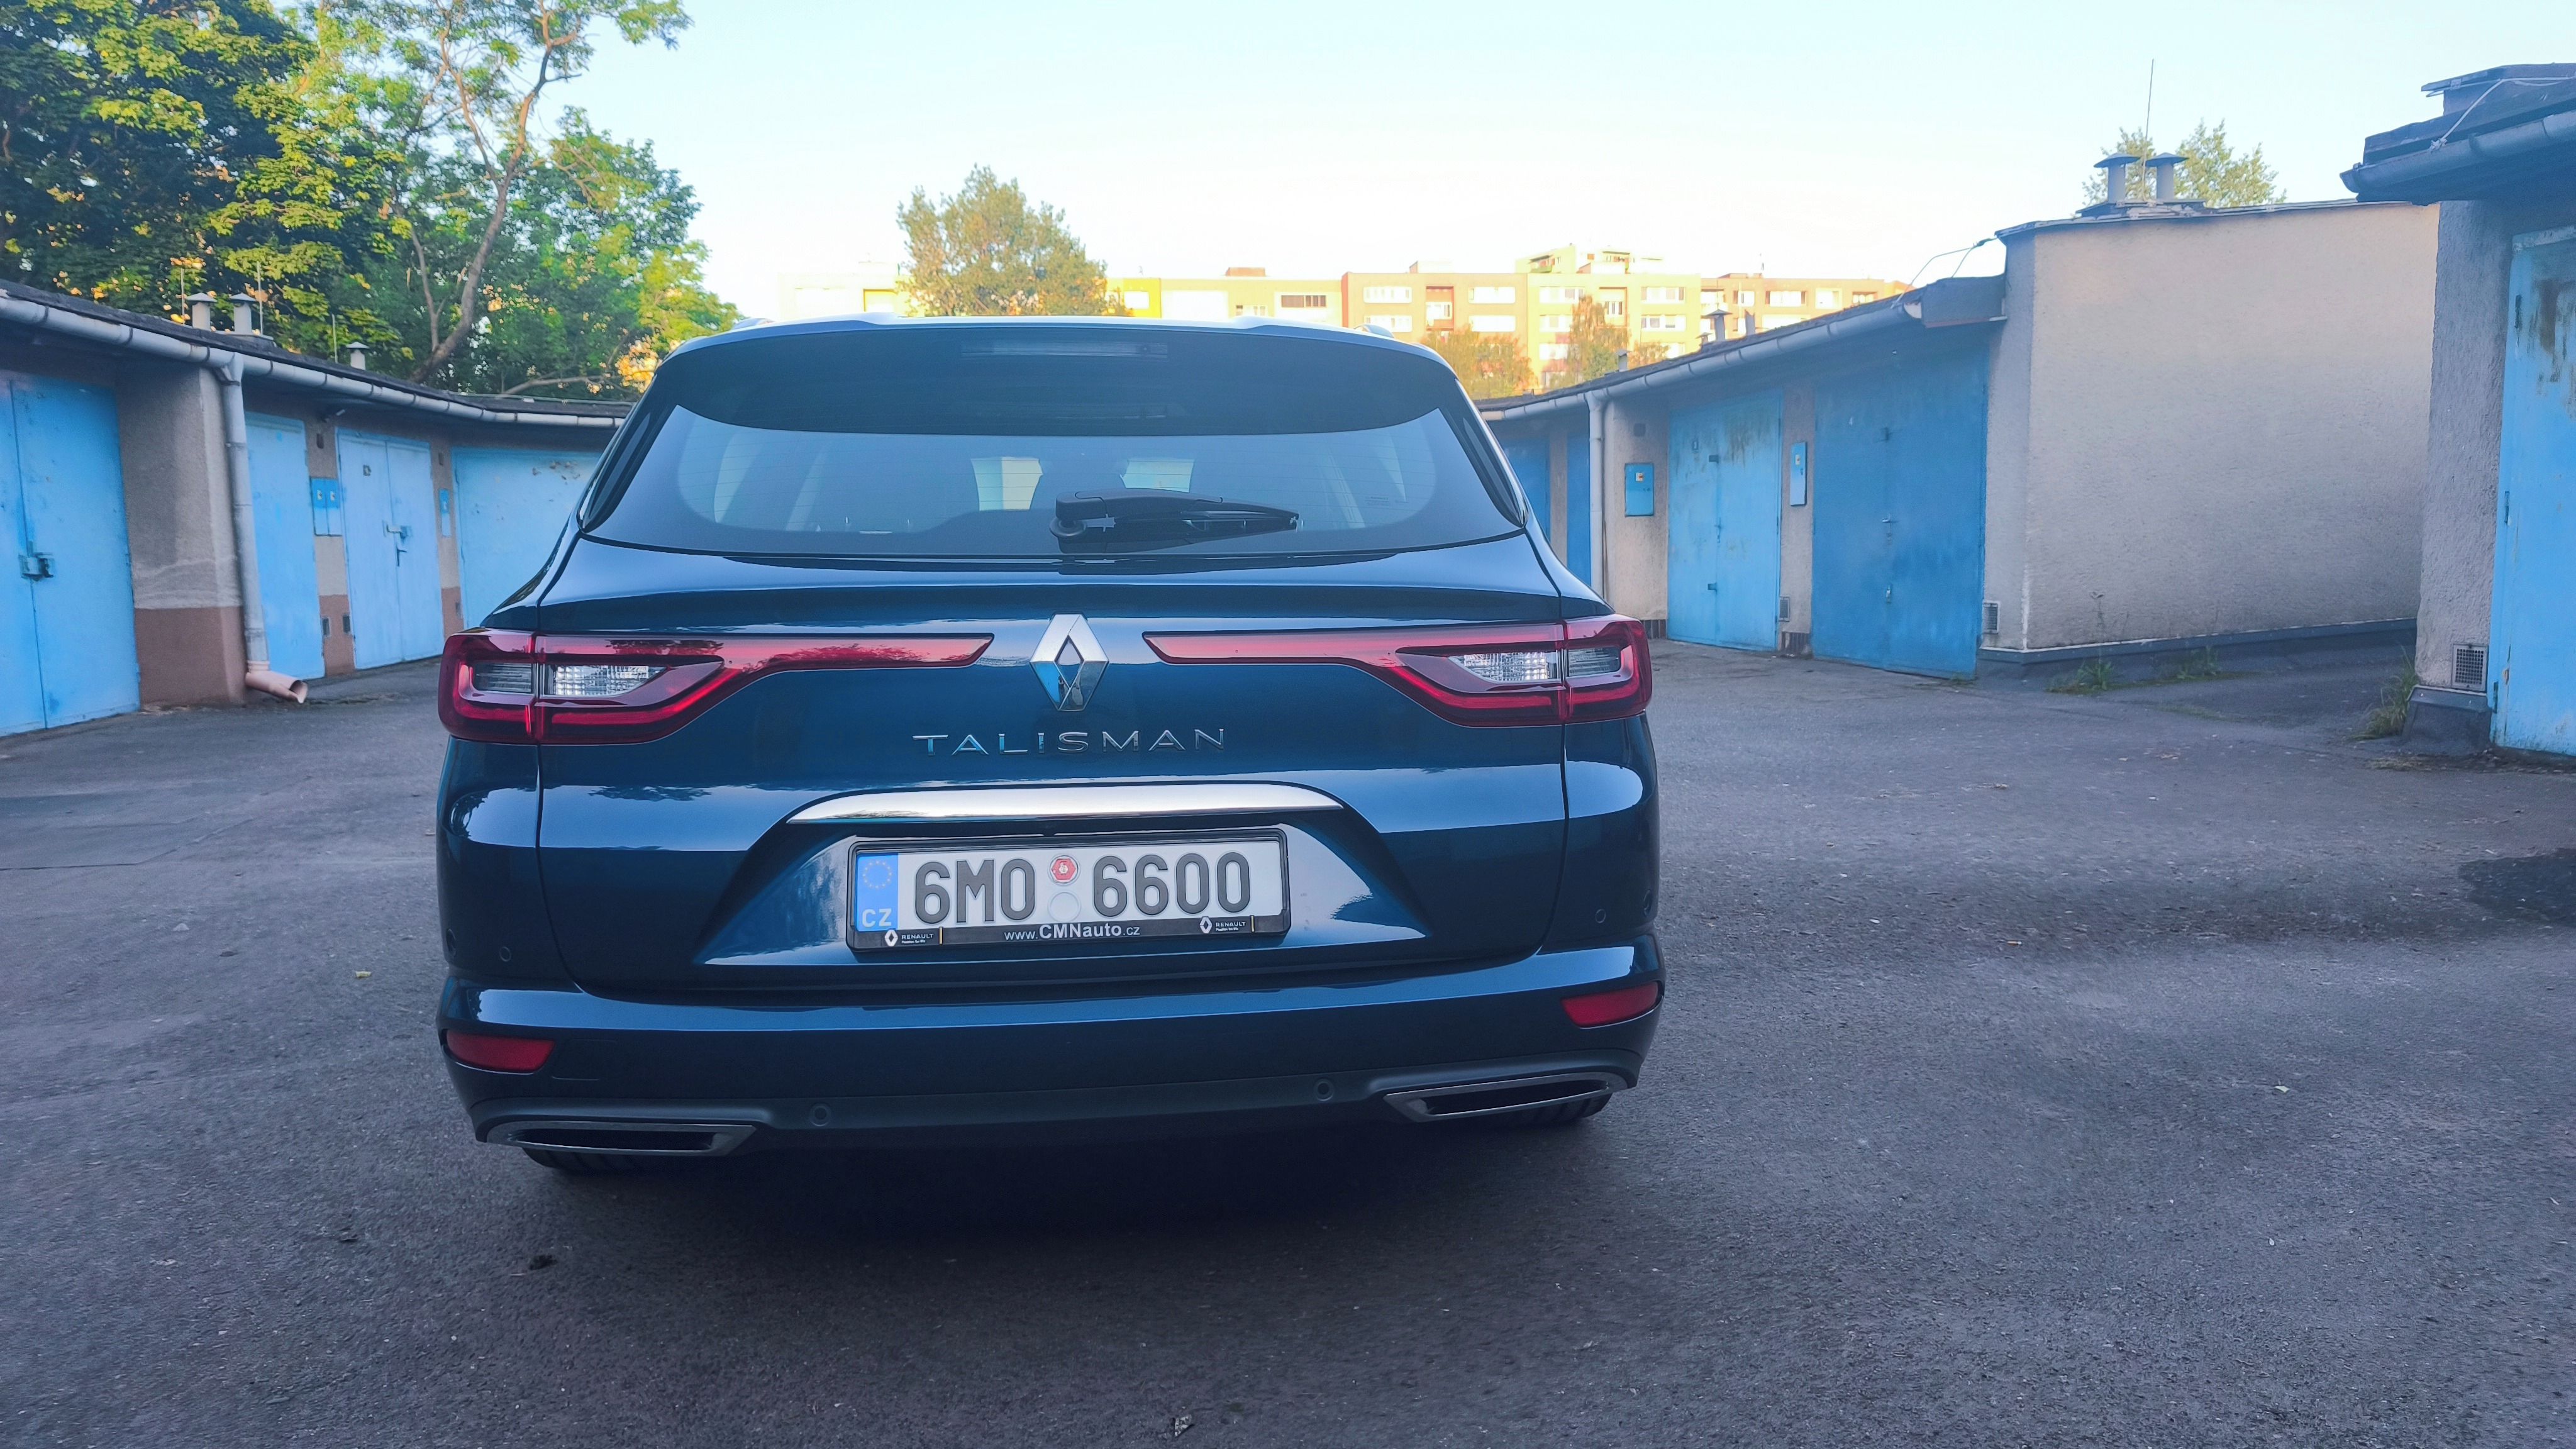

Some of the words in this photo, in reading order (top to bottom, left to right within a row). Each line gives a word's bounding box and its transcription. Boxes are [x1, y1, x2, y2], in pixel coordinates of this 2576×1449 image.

[913, 728, 1224, 755] TALISMAN
[1093, 852, 1250, 918] 6600
[862, 908, 892, 927] CZ
[1004, 923, 1140, 940] www.CMNauto.cz
